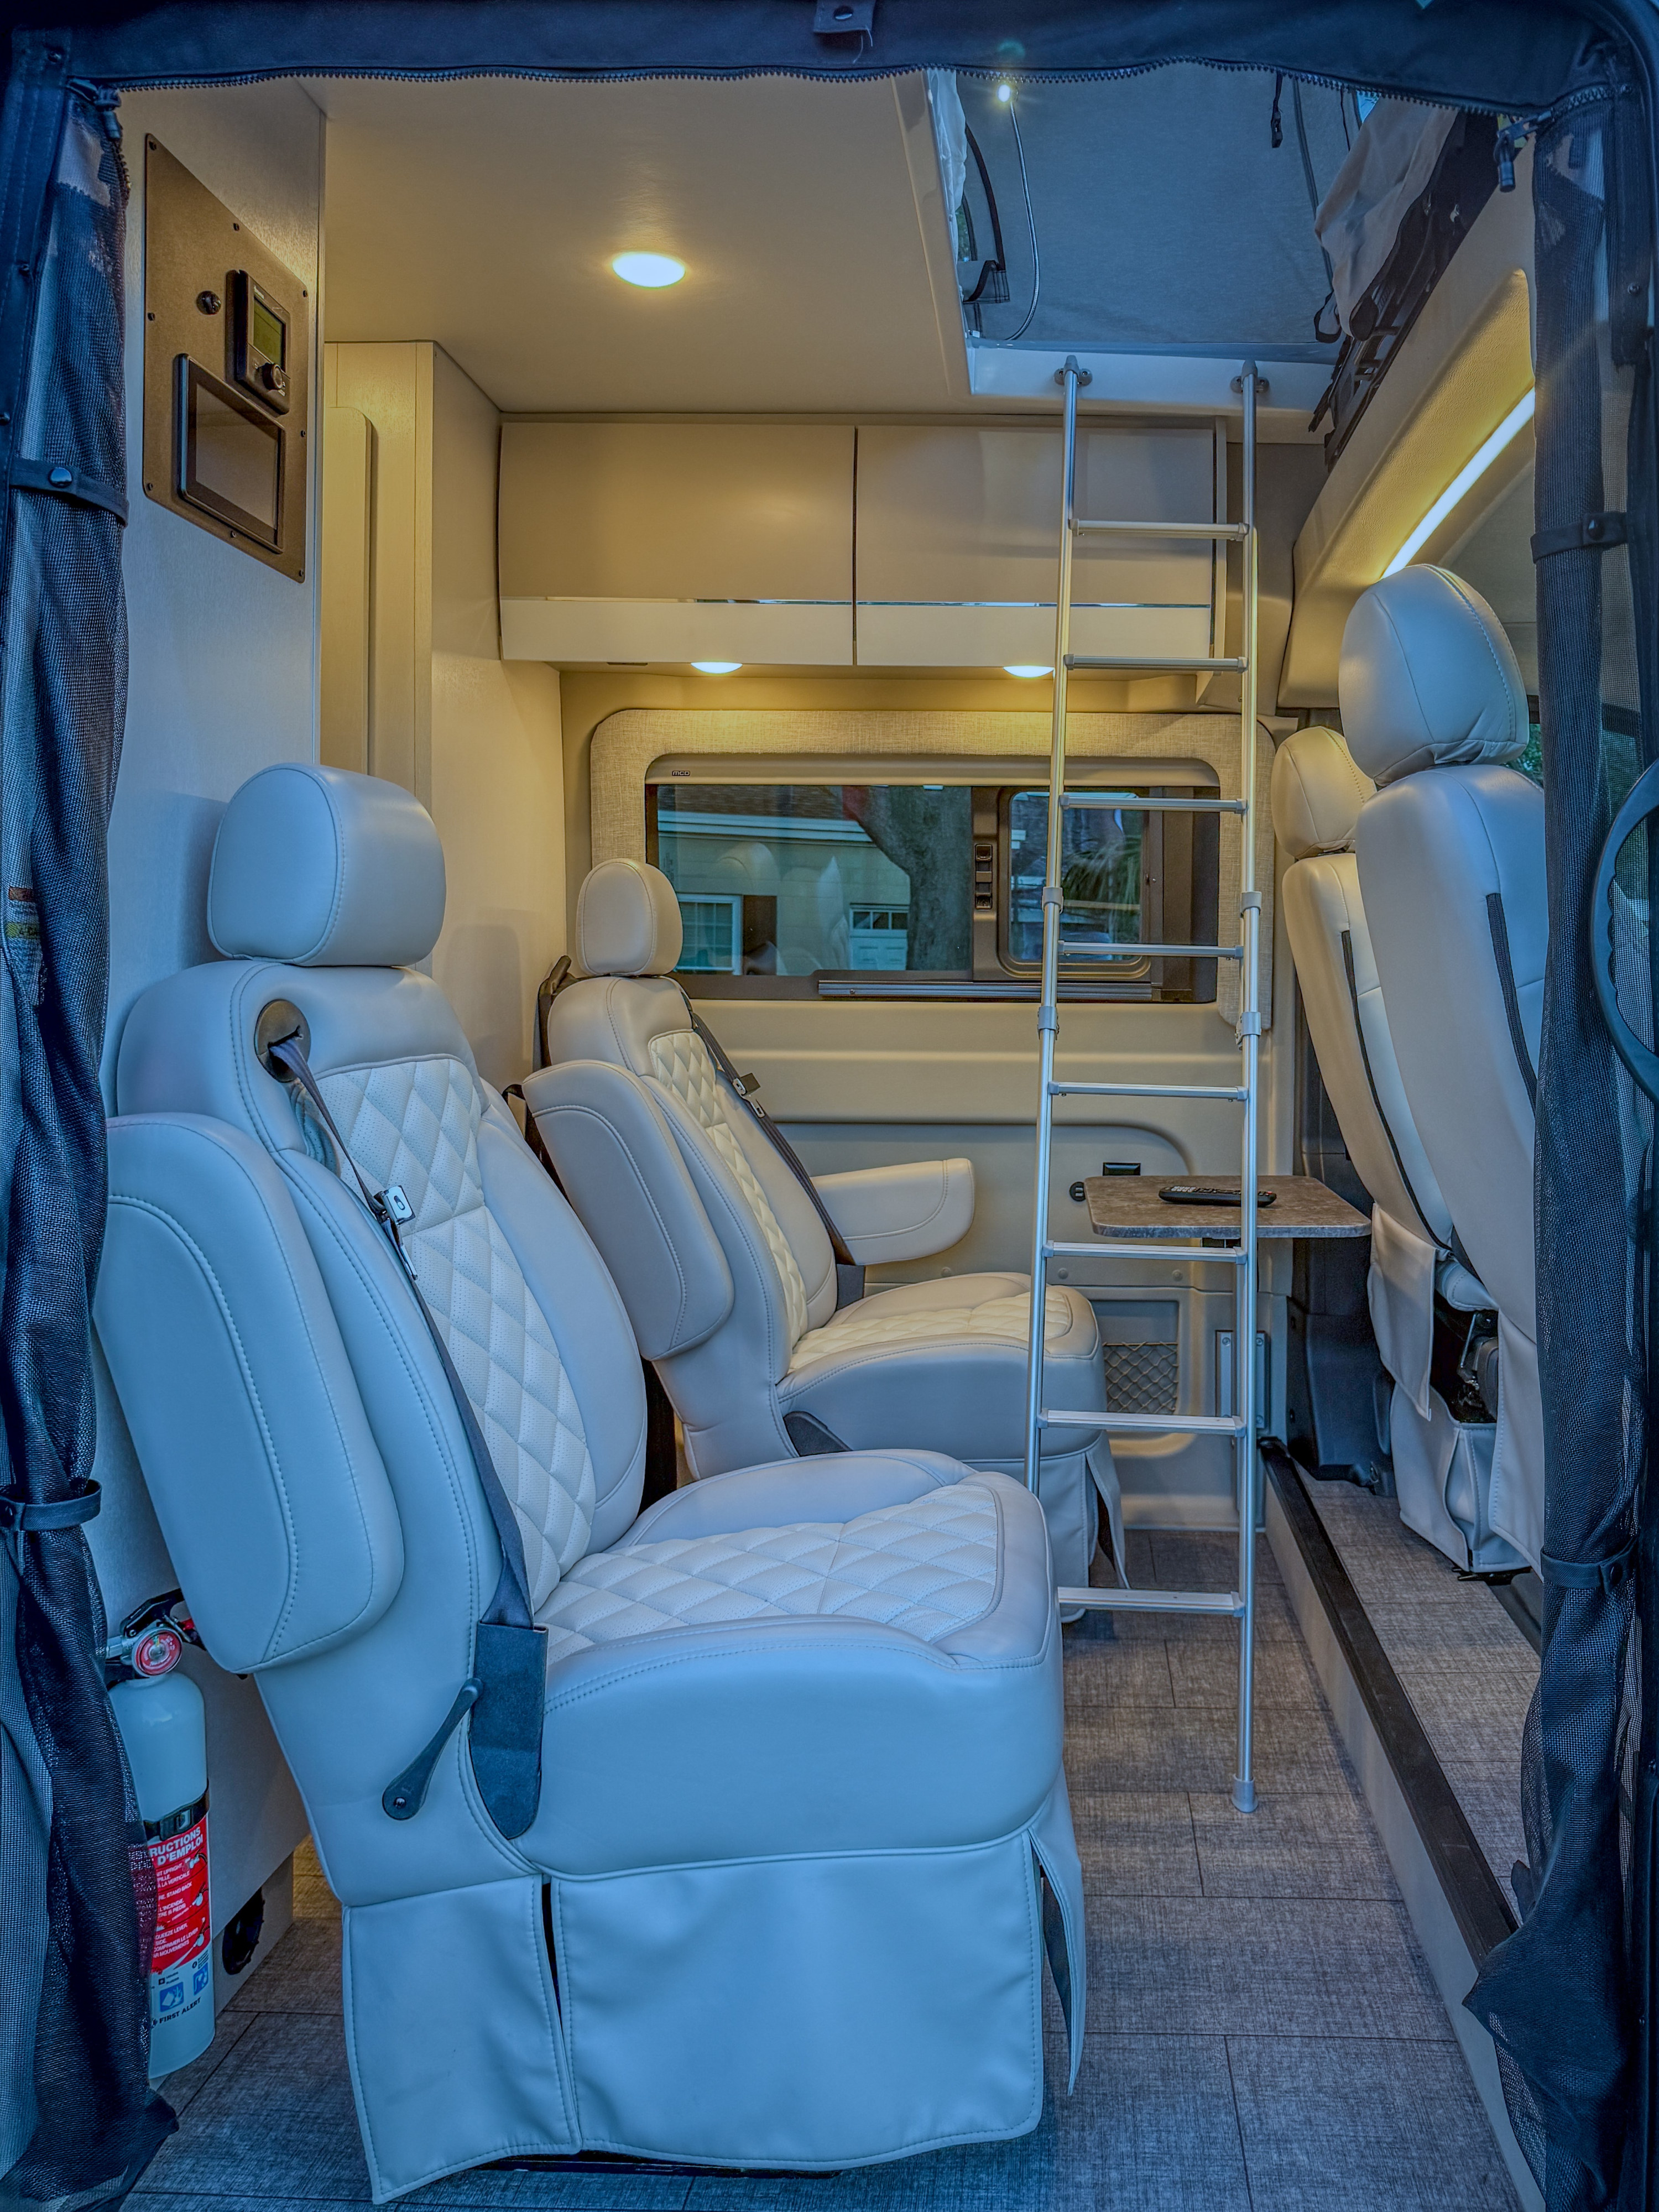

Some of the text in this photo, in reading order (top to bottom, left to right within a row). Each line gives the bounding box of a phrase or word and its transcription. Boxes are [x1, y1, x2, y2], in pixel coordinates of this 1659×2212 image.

[158, 1834, 203, 1866] D'EMPLOI
[163, 1863, 182, 1875] UPRIGHT
[168, 1870, 190, 1885] VERTICALE
[166, 1887, 181, 1898] STAND
[181, 1881, 192, 1891] BACK
[159, 1939, 190, 1957] MOUVEMENTS
[159, 1997, 201, 2023] FIRST ALERT
